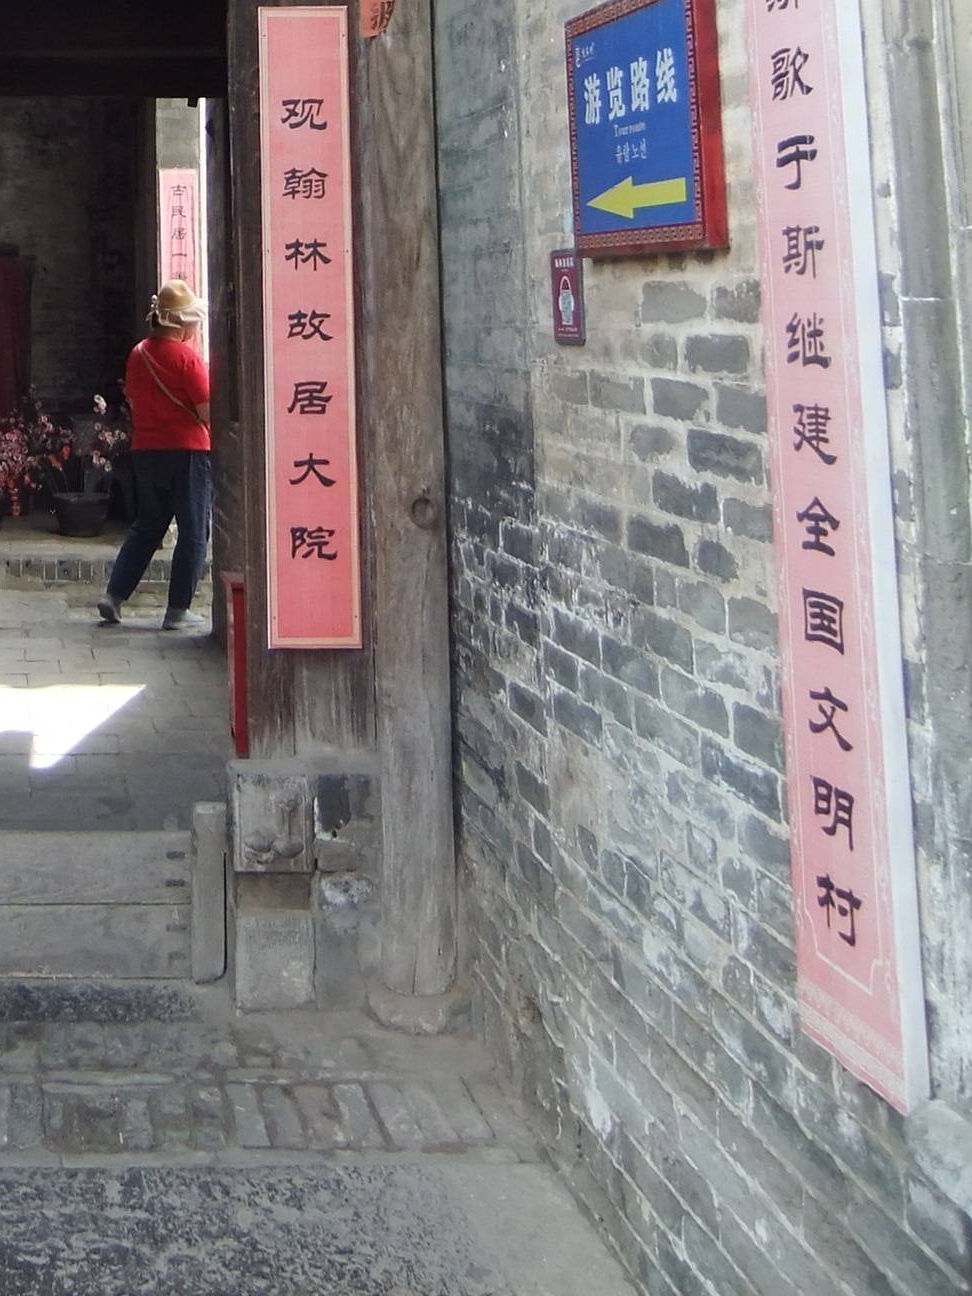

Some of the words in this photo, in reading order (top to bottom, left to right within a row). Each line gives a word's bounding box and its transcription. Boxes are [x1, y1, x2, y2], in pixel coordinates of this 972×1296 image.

[584, 47, 677, 125] 游览路线
[280, 97, 338, 562] 观翰林故居大院
